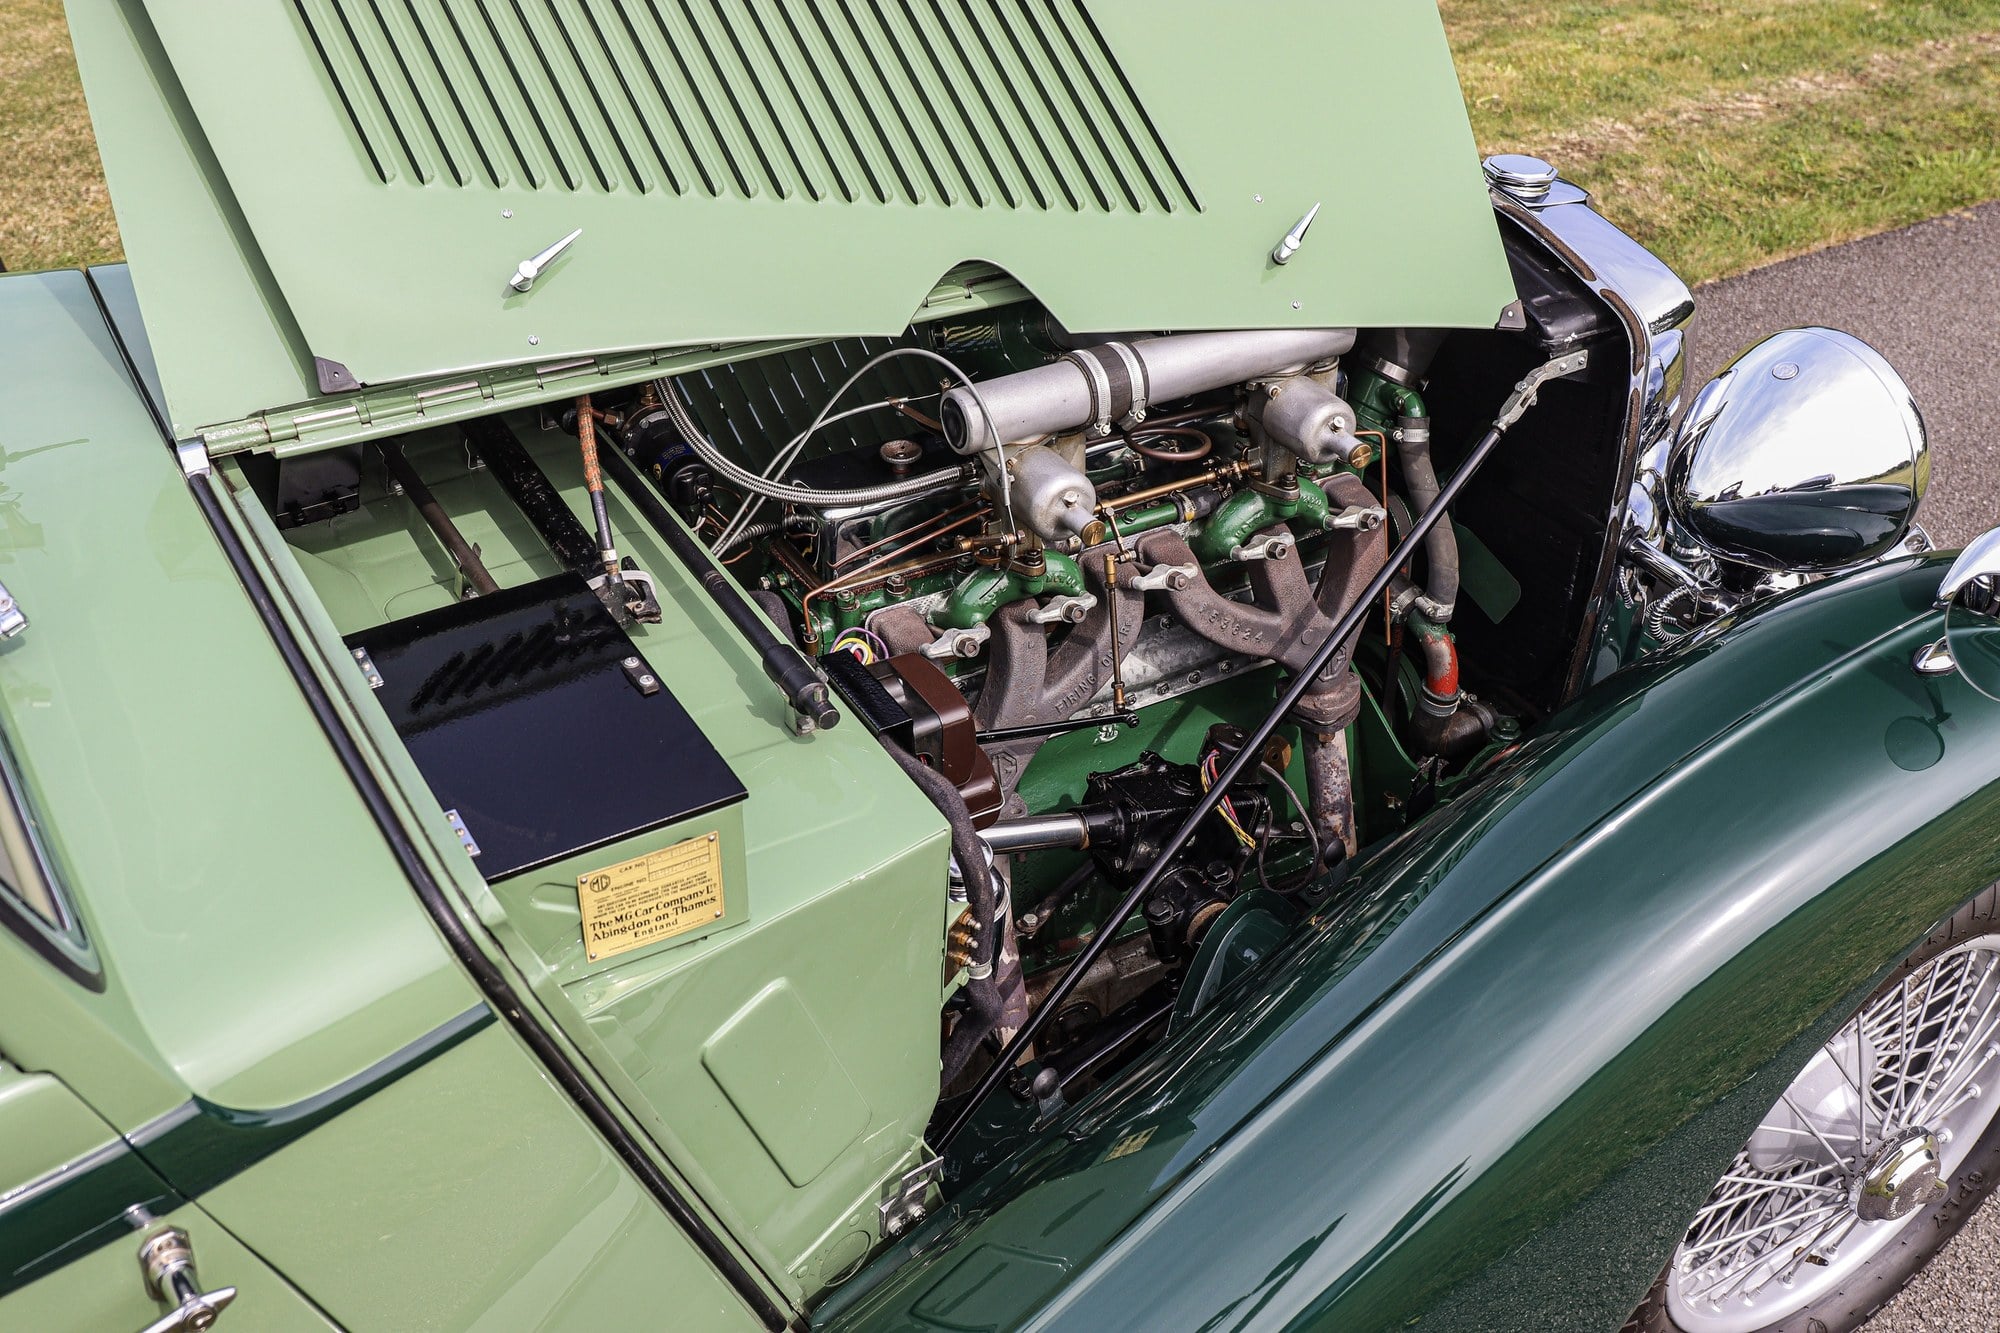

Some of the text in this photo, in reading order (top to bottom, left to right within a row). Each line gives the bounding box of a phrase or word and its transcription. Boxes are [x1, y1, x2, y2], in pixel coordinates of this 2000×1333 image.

[1054, 673, 1097, 714] FIRING
[619, 865, 632, 873] CAR
[590, 874, 611, 893] MG
[611, 881, 634, 892] ENGINE
[589, 920, 613, 931] The
[634, 906, 654, 917] Car
[655, 890, 705, 911] Company
[634, 918, 678, 938] England
